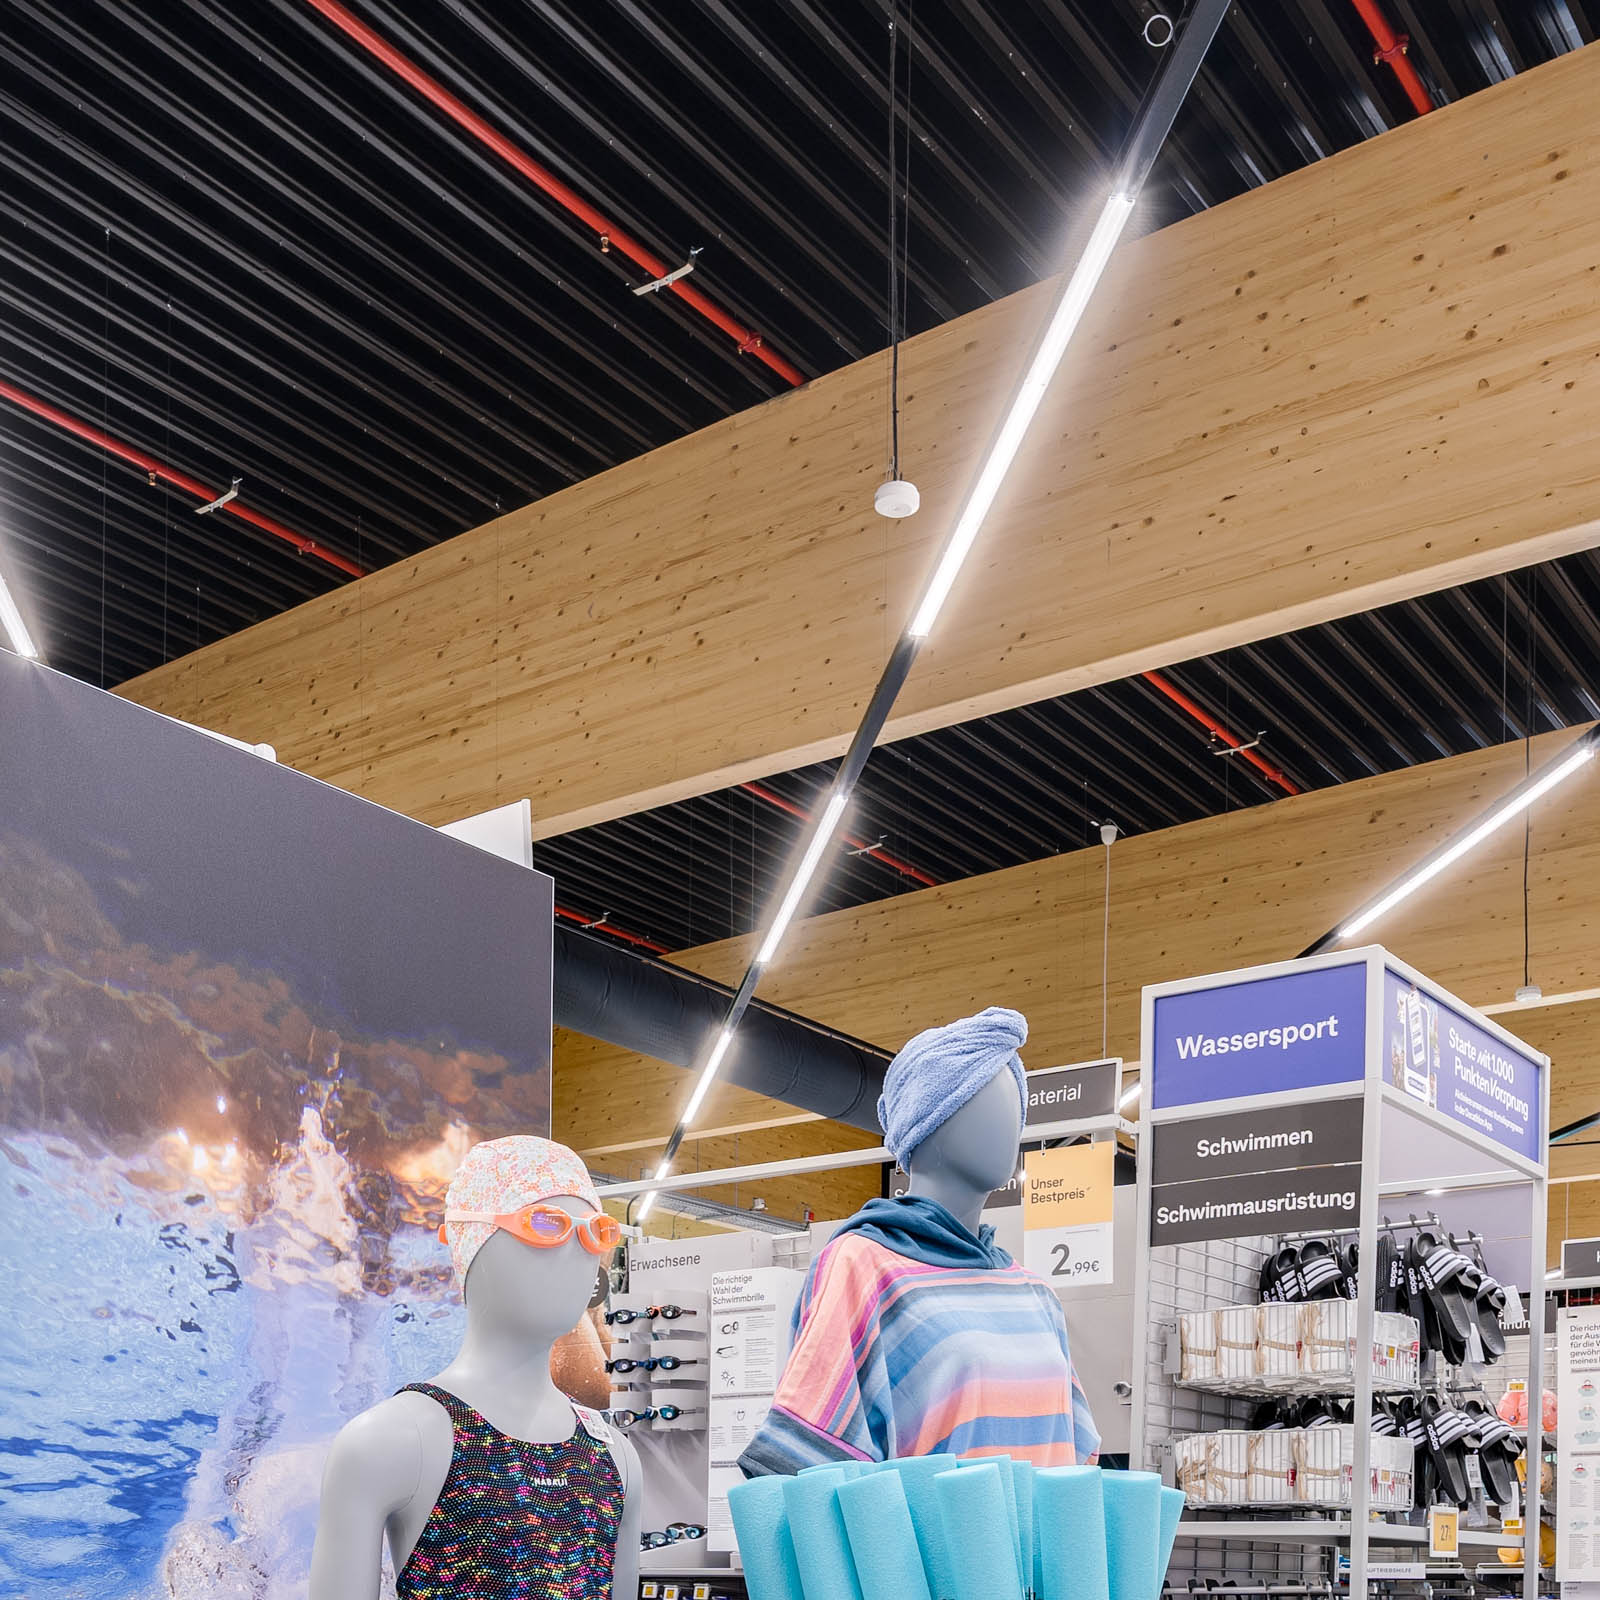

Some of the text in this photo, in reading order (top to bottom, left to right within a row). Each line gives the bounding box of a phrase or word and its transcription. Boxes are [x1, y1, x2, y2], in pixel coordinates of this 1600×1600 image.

[1175, 1015, 1339, 1060] Wassersport
[1448, 1027, 1477, 1060] Starte
[1454, 1056, 1490, 1096] Punkten
[1029, 1083, 1082, 1107] aterial
[1196, 1129, 1313, 1158] Schwimmen
[1031, 1176, 1064, 1190] Unser
[1031, 1187, 1085, 1205] Bestpreis
[1156, 1190, 1356, 1225] Schwimmausrüstung
[630, 1253, 701, 1272] Erwachsene
[1050, 1243, 1100, 1277] 2,99€
[712, 1274, 753, 1286] Die richtige
[1389, 1261, 1398, 1287] adidas
[1408, 1267, 1418, 1295] adidas
[1419, 1265, 1436, 1290] adidas
[712, 1285, 744, 1295] Wahl der
[712, 1293, 765, 1305] Schwimmbrille
[1570, 1325, 1584, 1333] Die
[1570, 1333, 1583, 1341] der
[1570, 1341, 1582, 1349] für
[1582, 1340, 1595, 1348] die
[1570, 1357, 1598, 1365] meines
[1426, 1423, 1440, 1451] adidas
